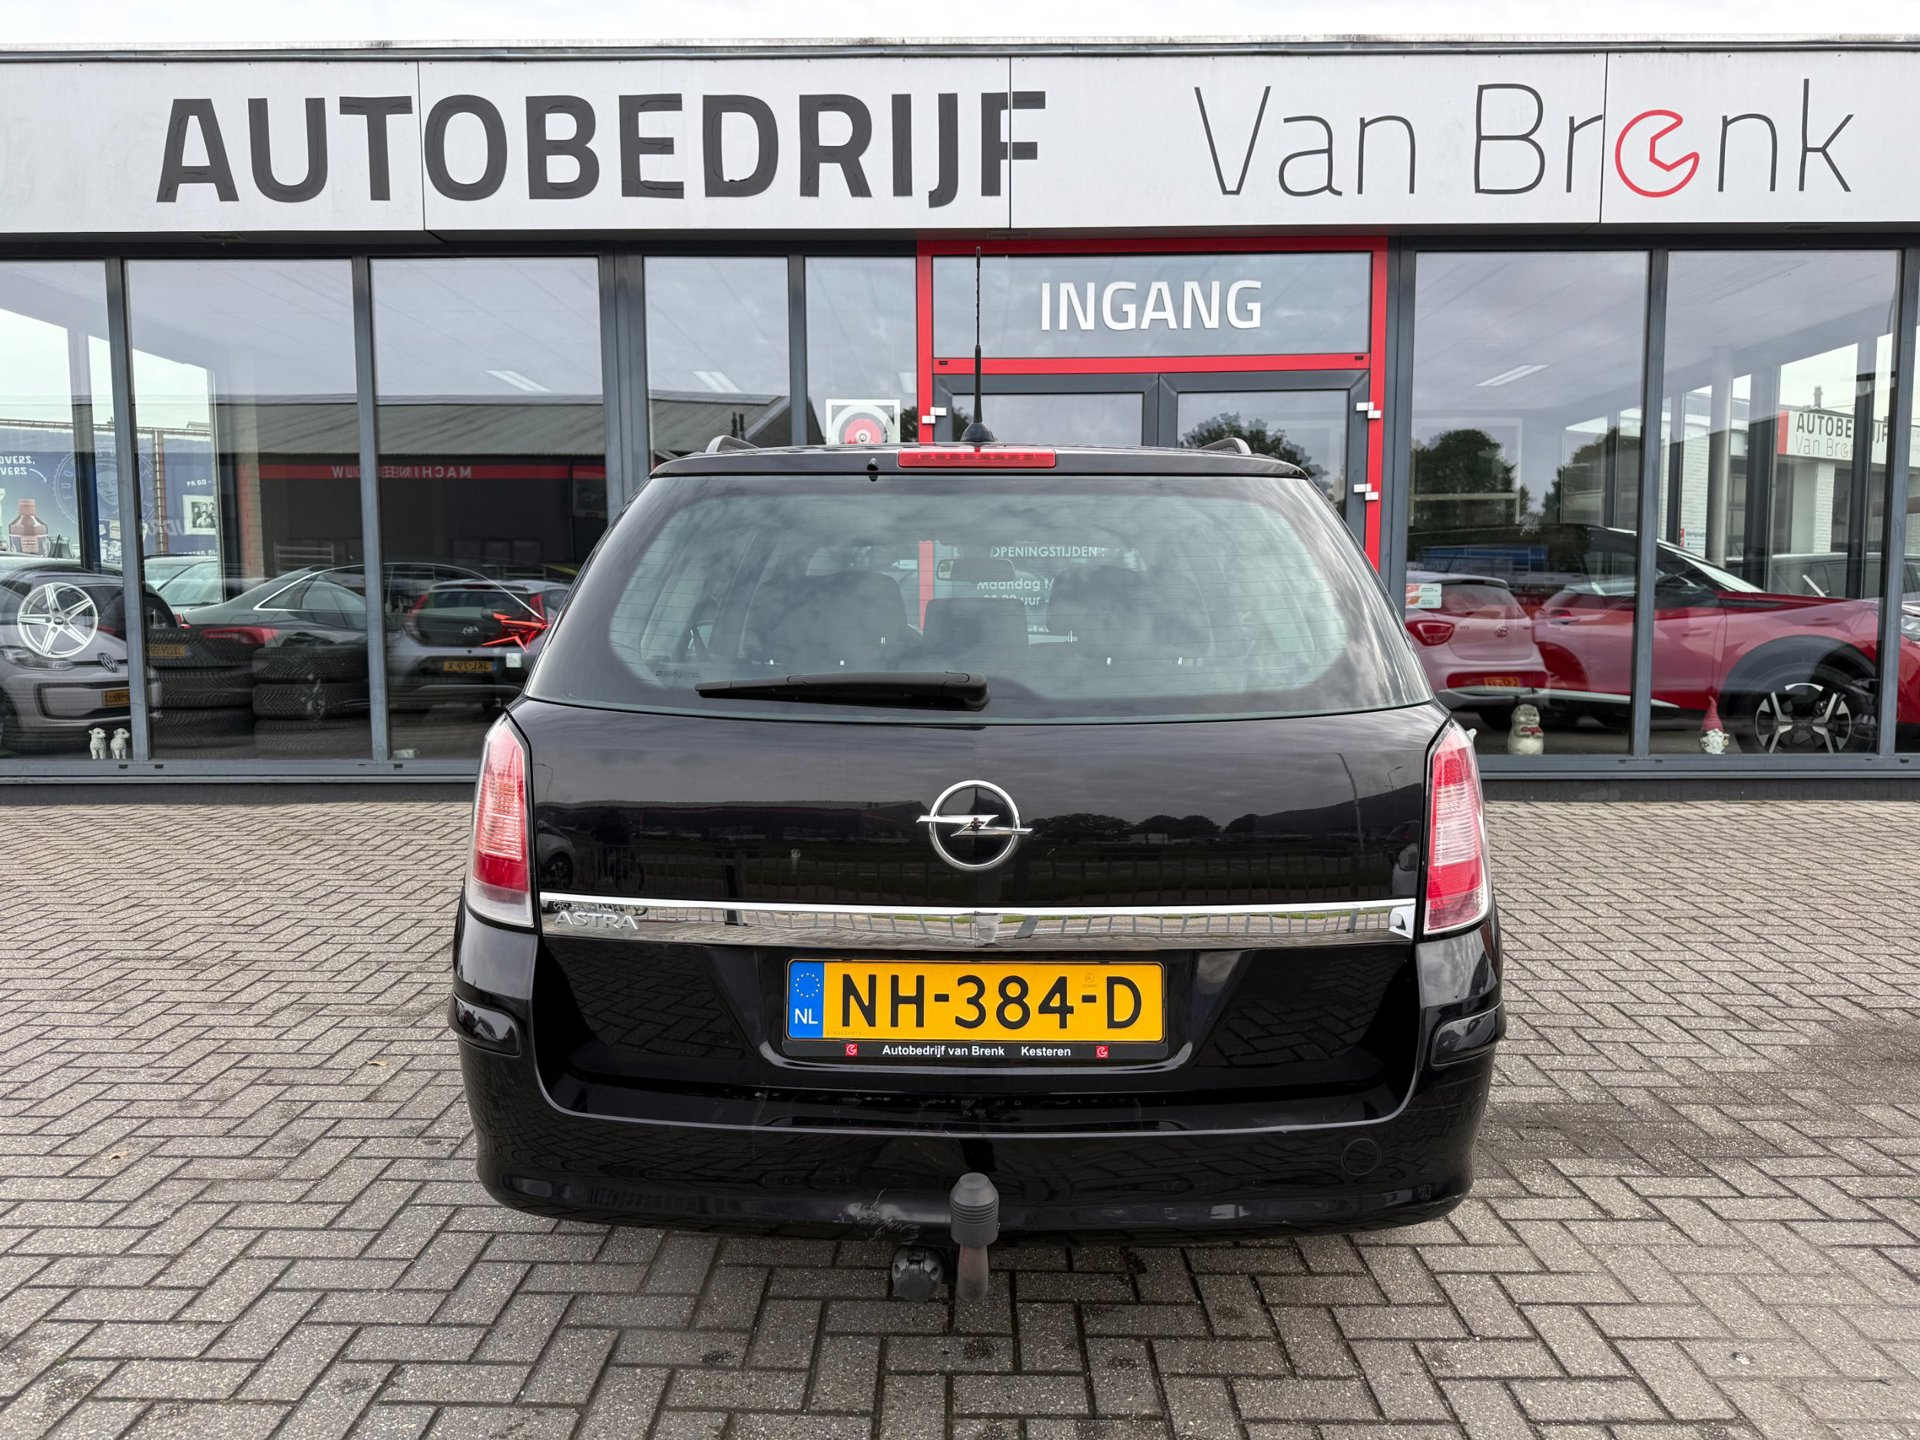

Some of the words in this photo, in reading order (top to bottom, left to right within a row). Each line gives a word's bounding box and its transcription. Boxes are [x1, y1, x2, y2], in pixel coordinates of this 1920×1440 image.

[156, 91, 1046, 208] AUTOBEDRIJF
[1194, 85, 1416, 197] Van
[1041, 280, 1262, 331] INGANG
[1796, 433, 1820, 455] Van
[555, 910, 638, 930] ASTRA
[794, 1008, 819, 1025] NL
[842, 974, 1142, 1030] NH-384-D
[882, 1045, 946, 1058] Autobedrijf
[949, 1048, 968, 1056] van
[971, 1046, 1005, 1057] Brenk
[1021, 1046, 1071, 1057] Kesteren
